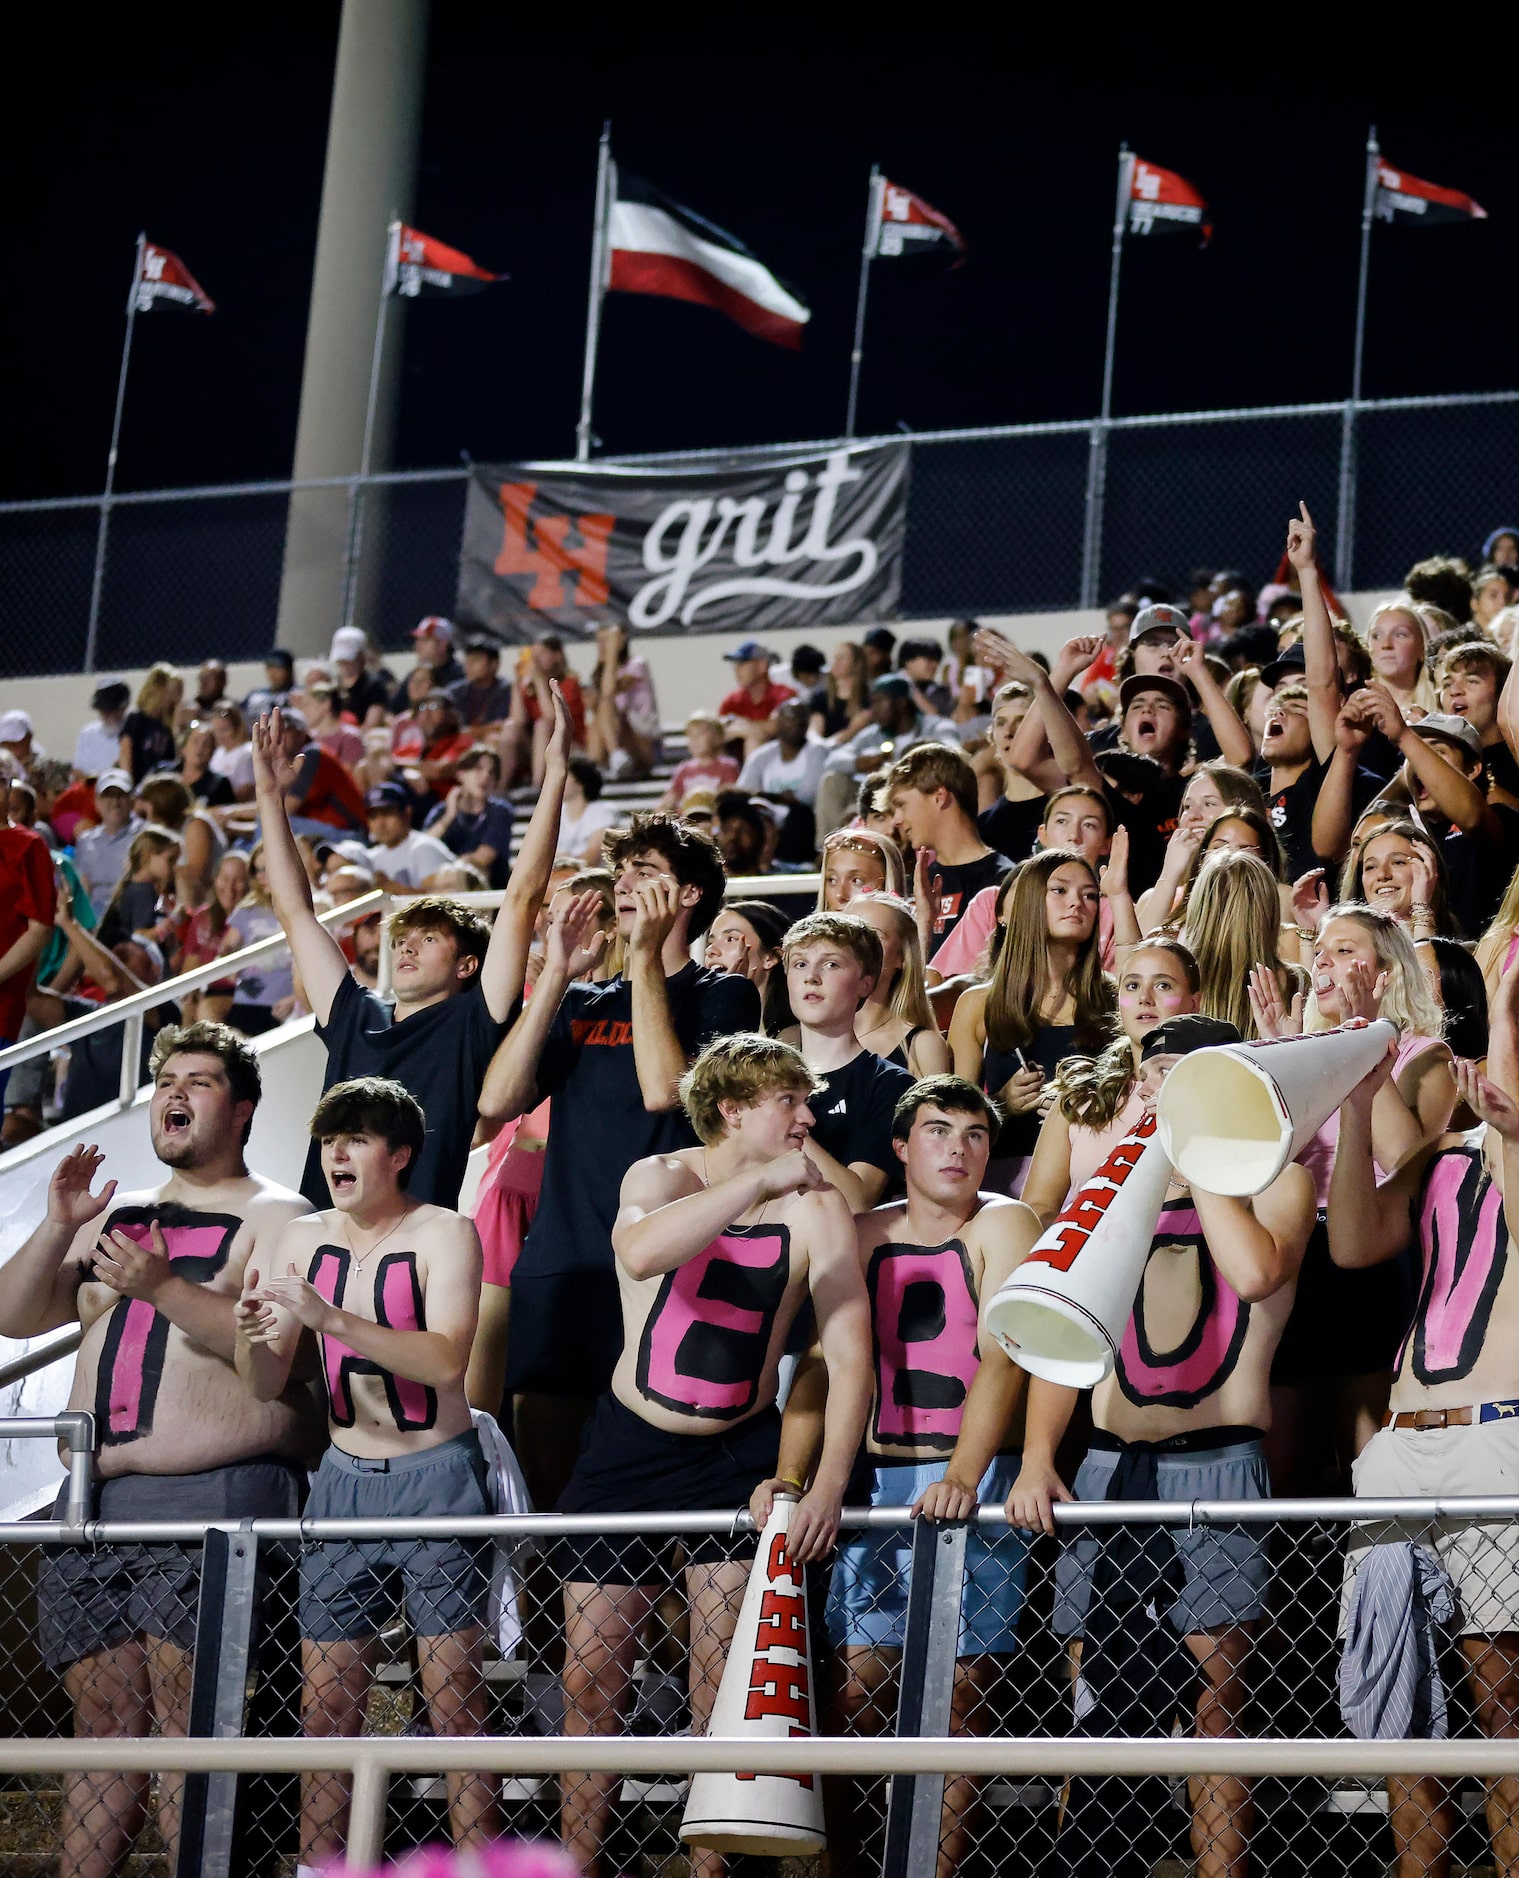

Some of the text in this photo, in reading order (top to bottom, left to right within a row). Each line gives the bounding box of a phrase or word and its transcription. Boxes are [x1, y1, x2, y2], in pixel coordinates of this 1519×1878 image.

[493, 452, 882, 631] LH grit
[308, 1244, 438, 1432] H
